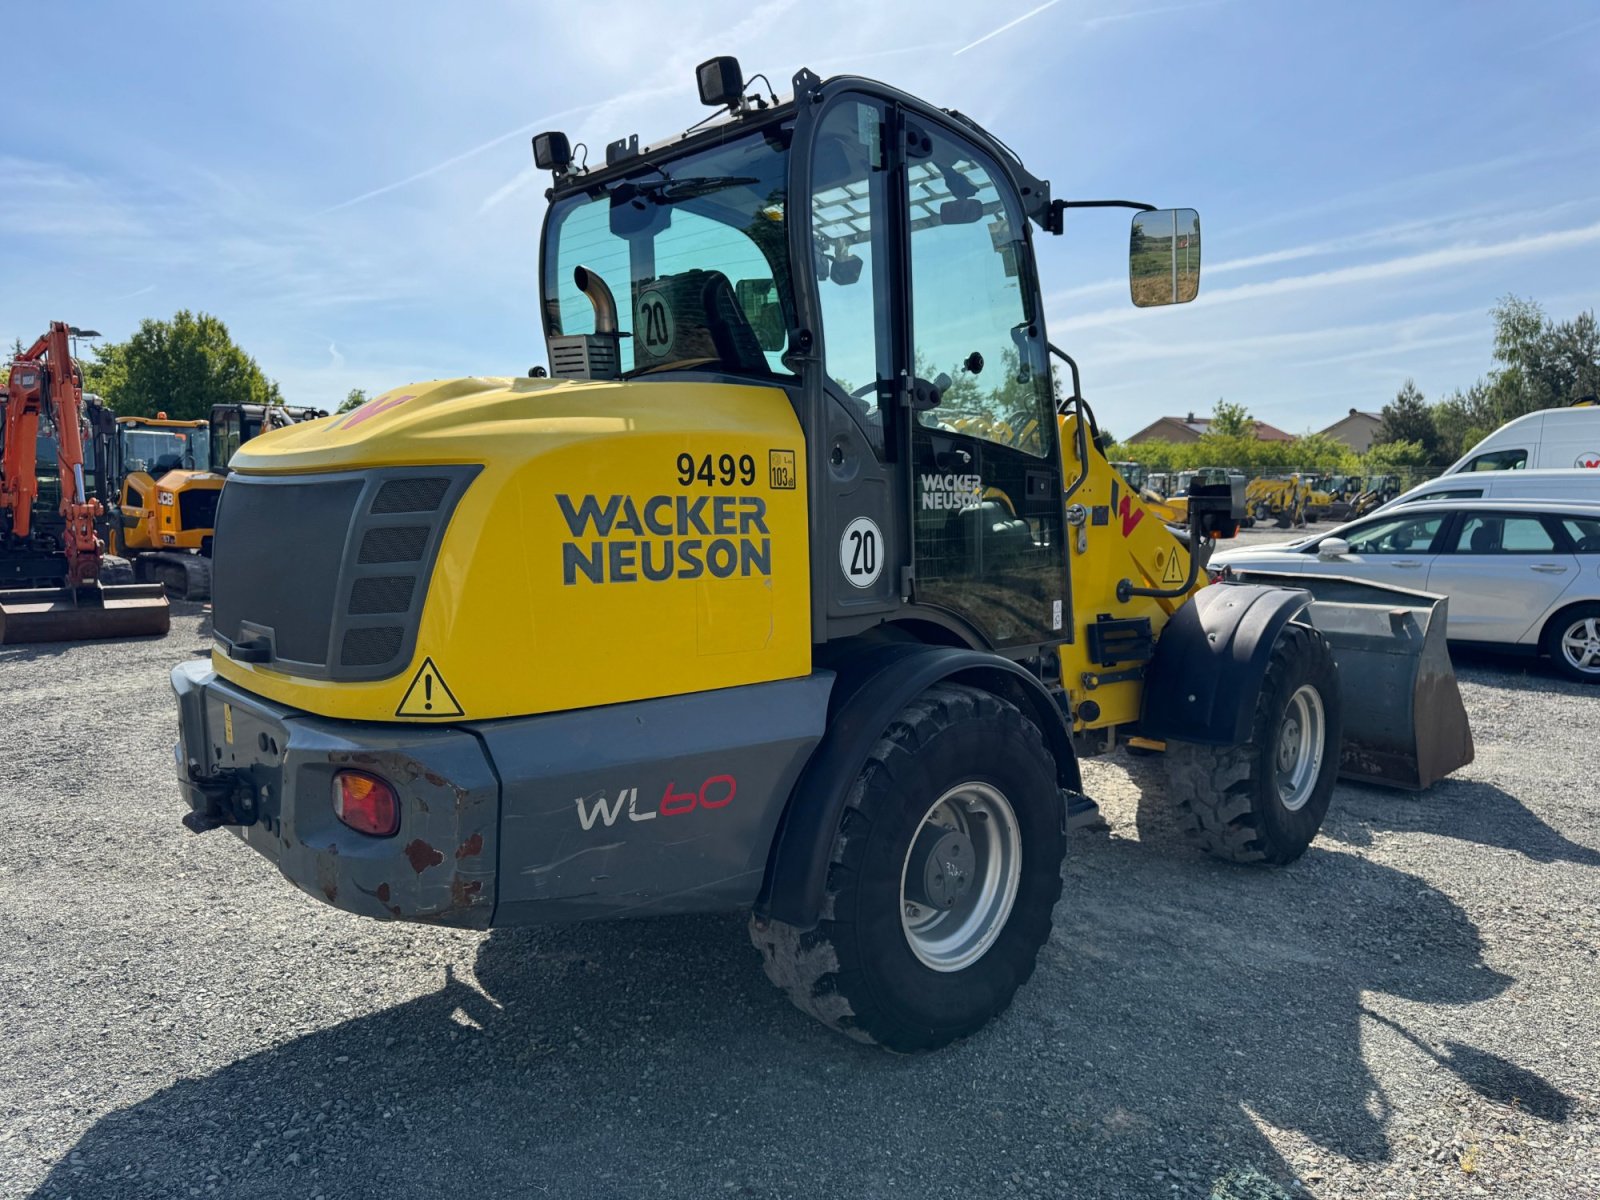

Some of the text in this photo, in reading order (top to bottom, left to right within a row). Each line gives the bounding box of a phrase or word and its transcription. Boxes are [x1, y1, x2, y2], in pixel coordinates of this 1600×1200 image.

[641, 302, 669, 346] 20
[677, 453, 755, 486] 9499
[772, 467, 788, 486] 103
[920, 474, 982, 491] WACKER
[158, 492, 173, 506] JCB
[554, 494, 771, 537] WACKER
[922, 492, 982, 509] NEUSON
[562, 538, 771, 585] NEUSON
[850, 530, 875, 575] 20
[575, 774, 737, 831] WL60
